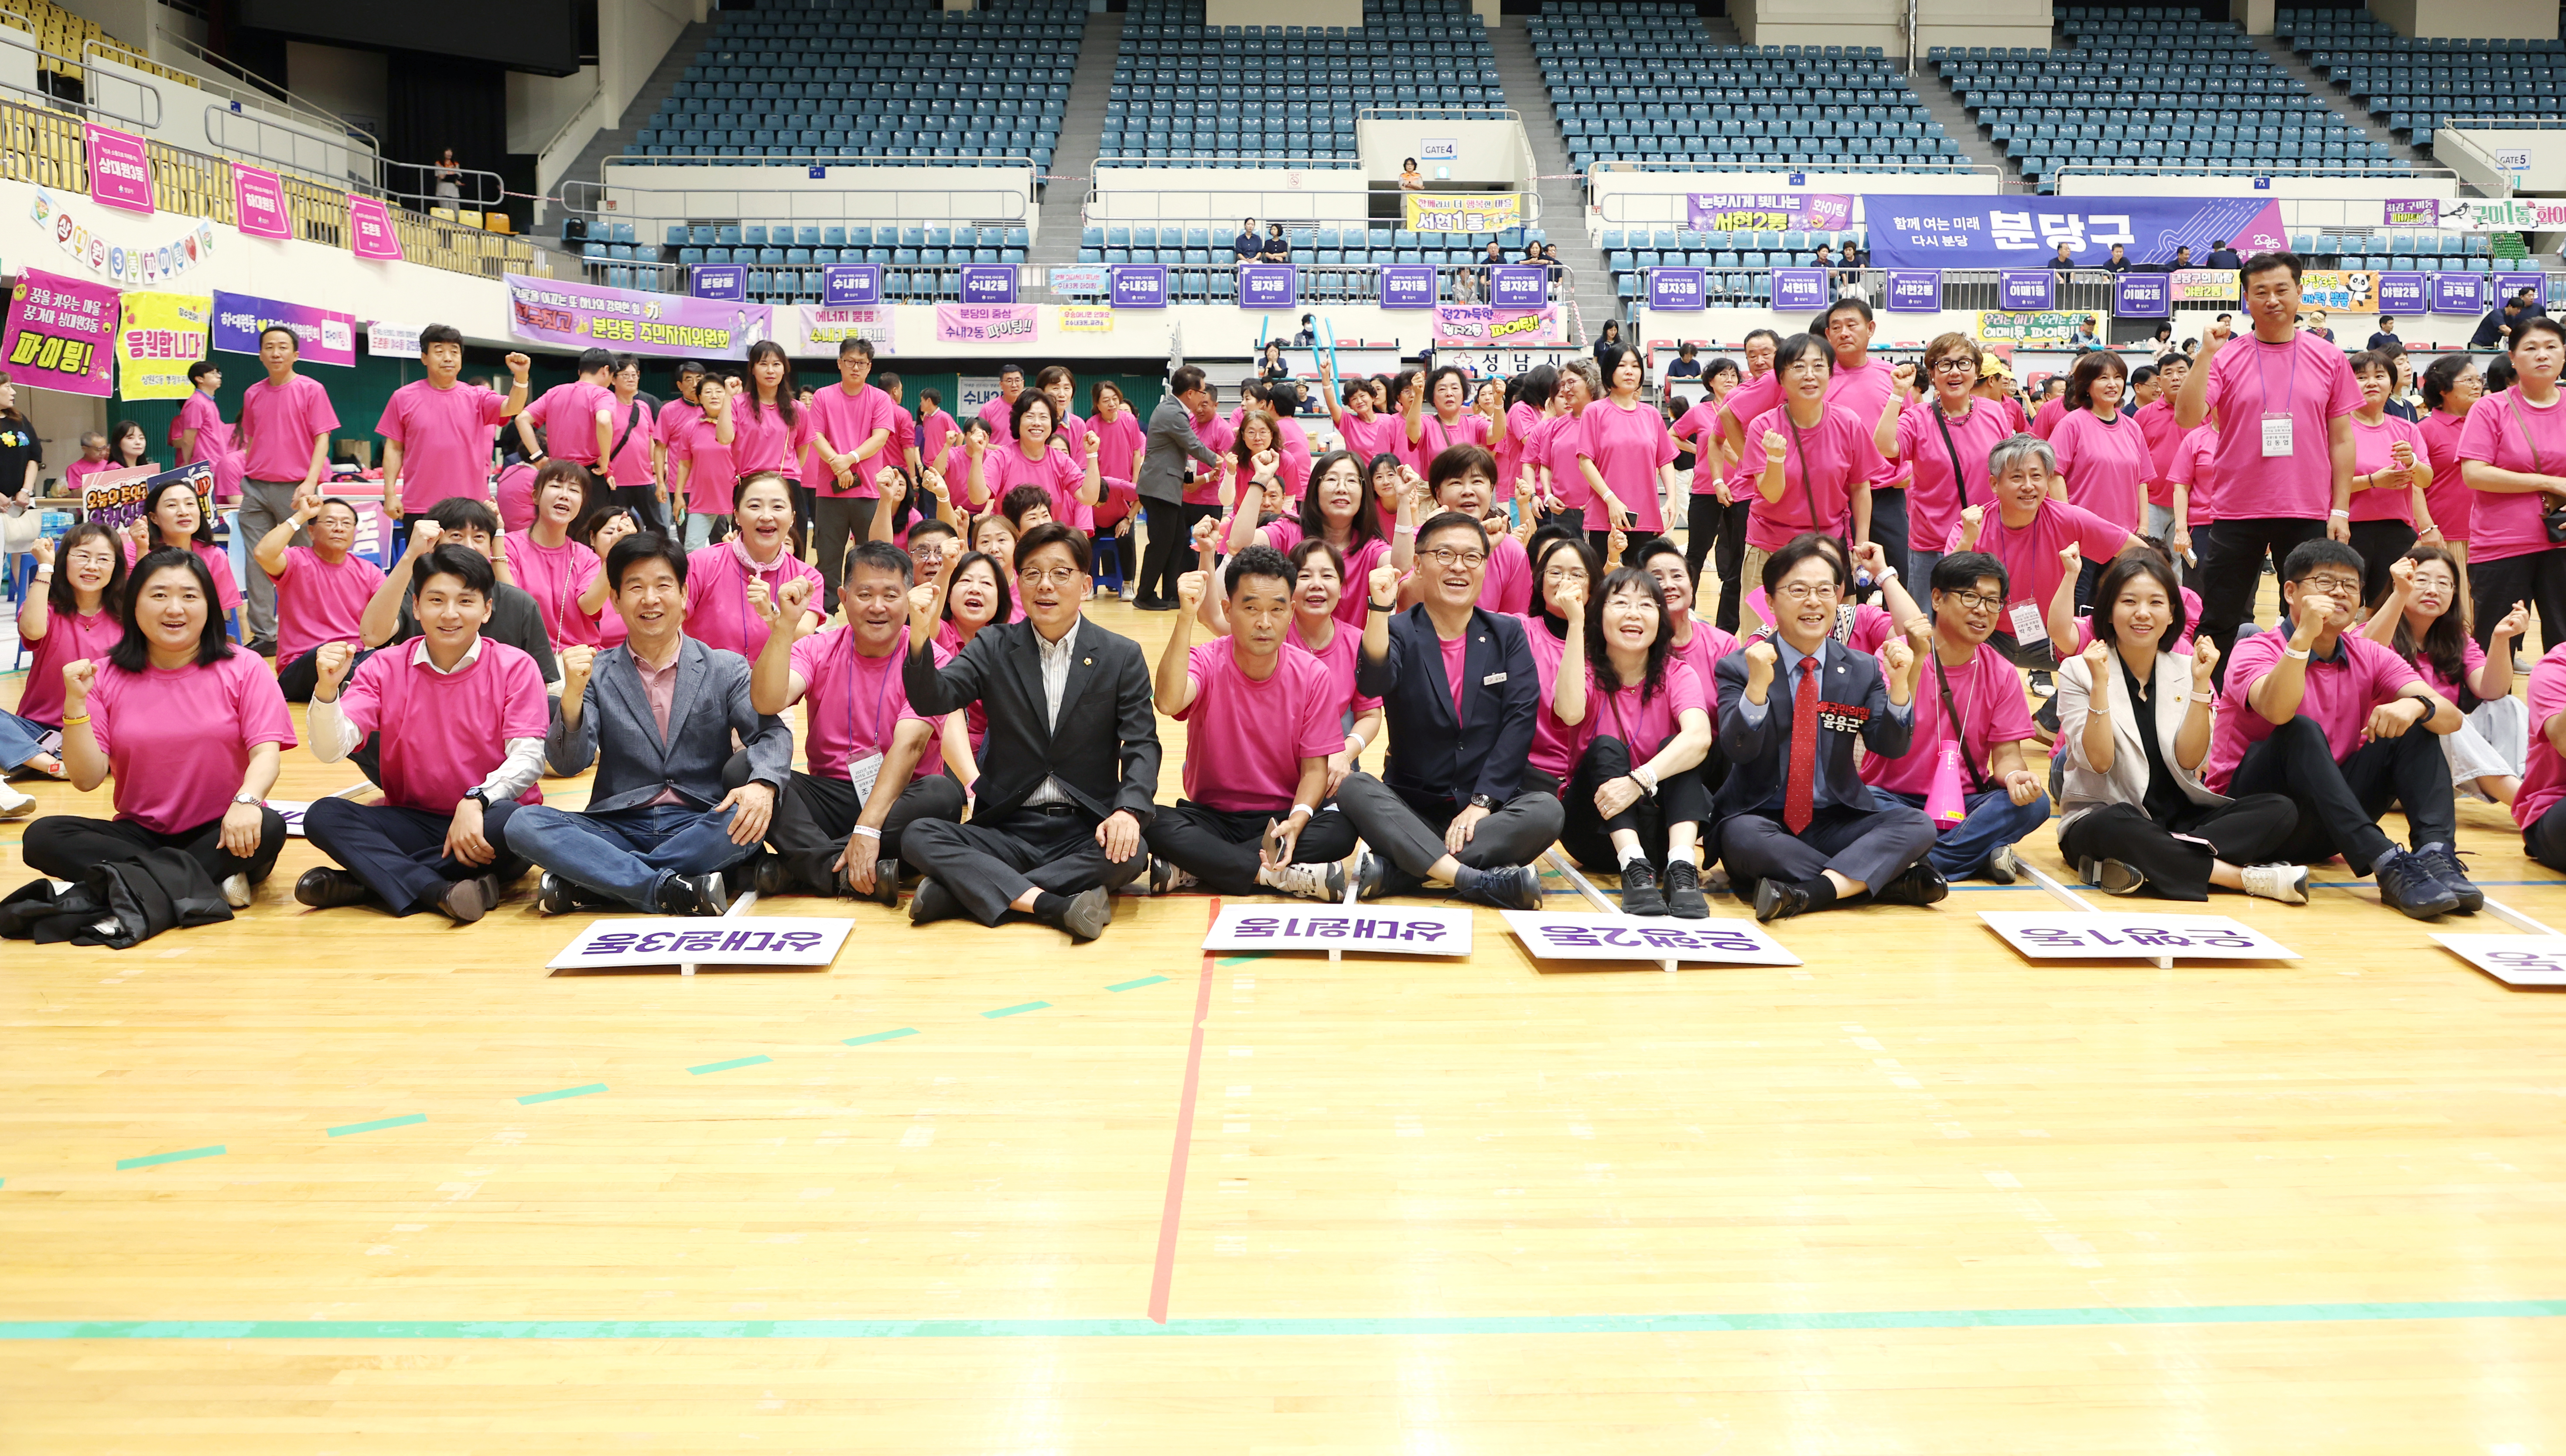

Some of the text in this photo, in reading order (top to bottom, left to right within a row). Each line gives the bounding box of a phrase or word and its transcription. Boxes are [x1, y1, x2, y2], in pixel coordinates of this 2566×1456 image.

[1446, 144, 1453, 154] 4
[2520, 155, 2526, 164] 5
[98, 157, 144, 182] 상대원3동
[245, 193, 276, 213] 하대원동
[1418, 199, 1513, 209] 함께라서 더 행복한 마을
[1699, 195, 1801, 210] 눈부시게 빛나는
[1811, 198, 1848, 216] 화이팅
[2386, 200, 2433, 212] 최강 구미동
[2391, 213, 2425, 223] 파이팅!
[2471, 201, 2530, 225] 구미1동
[1417, 210, 1485, 232] 서현1동
[1712, 212, 1790, 232] 서현2동
[1893, 216, 1980, 231] 함께 여는 미래
[1989, 210, 2135, 253] 분당구
[1911, 235, 1968, 247] 다시 분당
[2253, 234, 2281, 249] 2025
[701, 277, 734, 289] 분당동
[832, 278, 870, 290] 수내1동
[968, 280, 1008, 291] 수내2동
[1118, 280, 1158, 291] 수내3동
[1251, 280, 1285, 291] 정자동
[1390, 280, 1427, 291] 정자1동
[1500, 280, 1539, 291] 정자2동
[2171, 273, 2234, 284] 분당구의 자랑
[2300, 274, 2338, 290] 야탑3동
[1657, 283, 1697, 294] 정자3동
[1781, 283, 1818, 294] 서현1동
[1895, 284, 1934, 296] 서현2동
[2010, 285, 2045, 297] 이매1동
[2123, 289, 2160, 301] 이매2동
[2183, 286, 2222, 297] 야탑2동
[2381, 287, 2419, 298] 야탑2동
[2443, 286, 2475, 297] 금곡동
[30, 287, 101, 317] 꿈을 키우는 마을
[541, 291, 567, 307] 이끄는
[569, 295, 578, 308] 또
[579, 296, 605, 311] 하나의
[606, 300, 631, 314] 강력한
[632, 302, 641, 315] 힘
[2302, 291, 2349, 307] 매력 뿜뿜
[23, 304, 100, 333] 꿈가마 상대원3동
[816, 311, 874, 322] 에너지 뿜뿜
[960, 309, 1011, 319] 분당의 중심
[1442, 308, 1493, 320] 정2가득한
[1983, 313, 2090, 325] 우리는 하나 우리는 최고
[220, 311, 256, 334] 하대원동
[946, 319, 1033, 338] 수내2동 파이팅!!
[1442, 314, 1540, 338] 정자2동 파이팅!
[591, 316, 636, 342] 분당동
[639, 321, 731, 349] 주민자치위원회
[810, 328, 886, 343] 수내1동 짱!!!
[126, 330, 205, 359] 응원합니다!
[9, 330, 95, 376] 파이팅!
[964, 391, 1003, 405] 수내2
[87, 482, 148, 509] 오늘의 주인공
[1827, 701, 1870, 720] 국민의힘
[1823, 713, 1861, 733] 윤용근
[867, 762, 881, 771] 주민자치
[858, 779, 874, 788] 상대원3동
[1233, 918, 1447, 942] 상대원1동
[581, 931, 823, 955] 상대원3동
[1539, 925, 1761, 951] 은행2동
[2019, 928, 2255, 948] 은행1동
